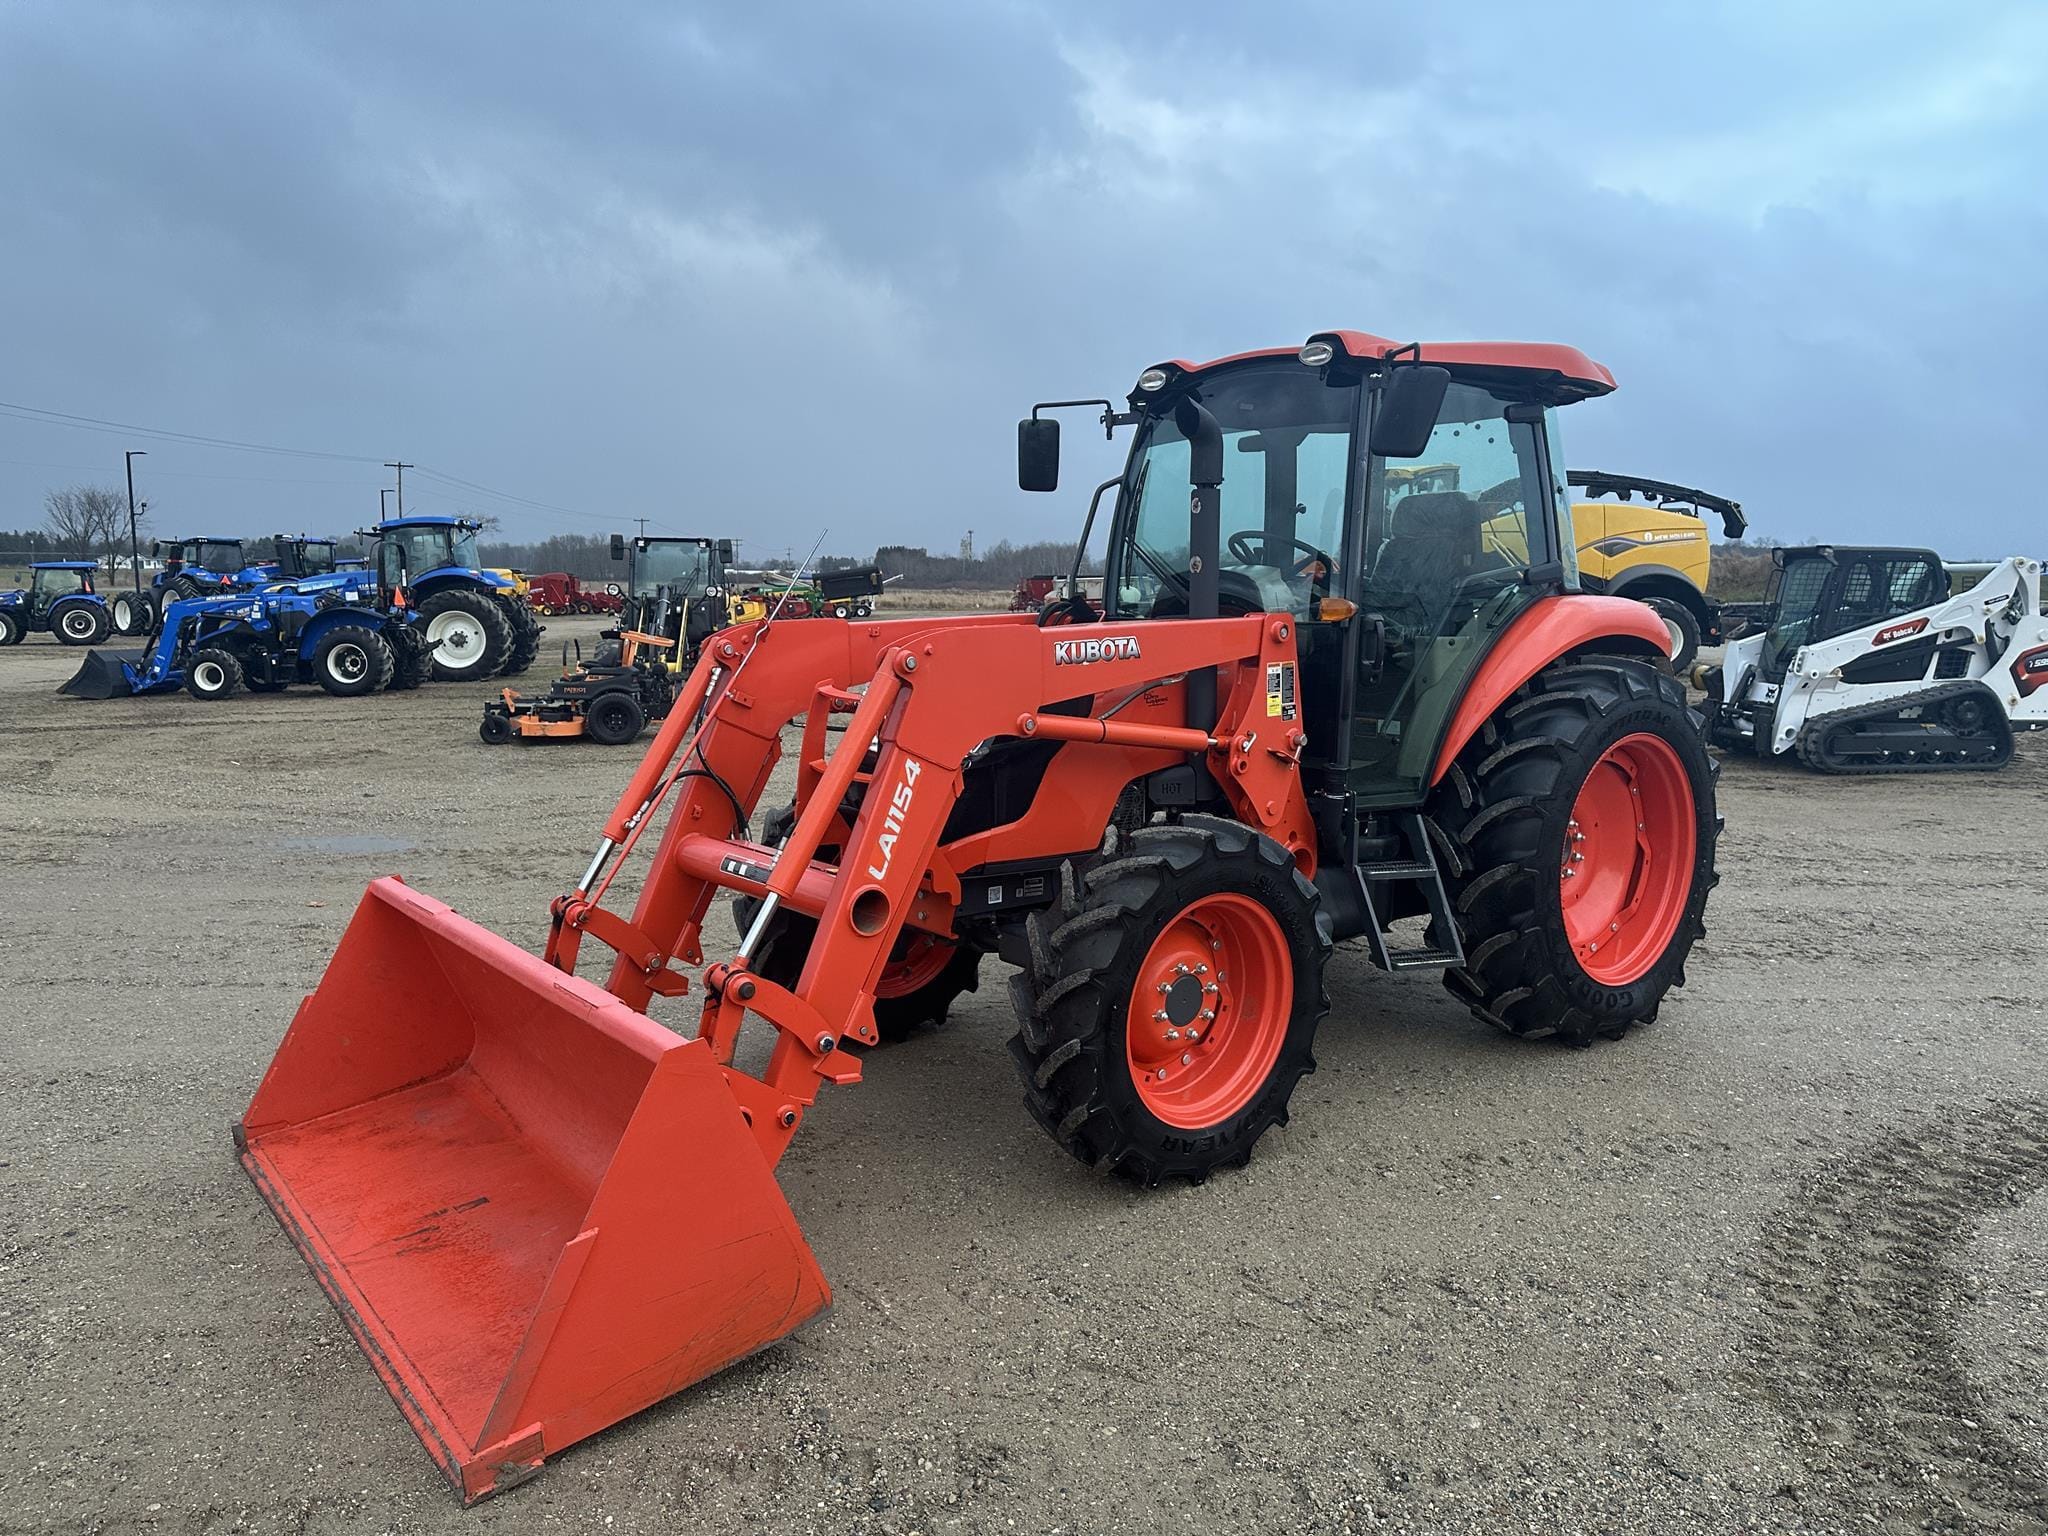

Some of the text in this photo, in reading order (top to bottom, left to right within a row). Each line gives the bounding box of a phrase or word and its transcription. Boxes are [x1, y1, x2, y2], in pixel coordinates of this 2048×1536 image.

[1892, 626, 1914, 638] Bobcat
[1055, 637, 1140, 665] KUBOTA
[1161, 782, 1182, 794] HOT
[868, 758, 921, 880] LA1154
